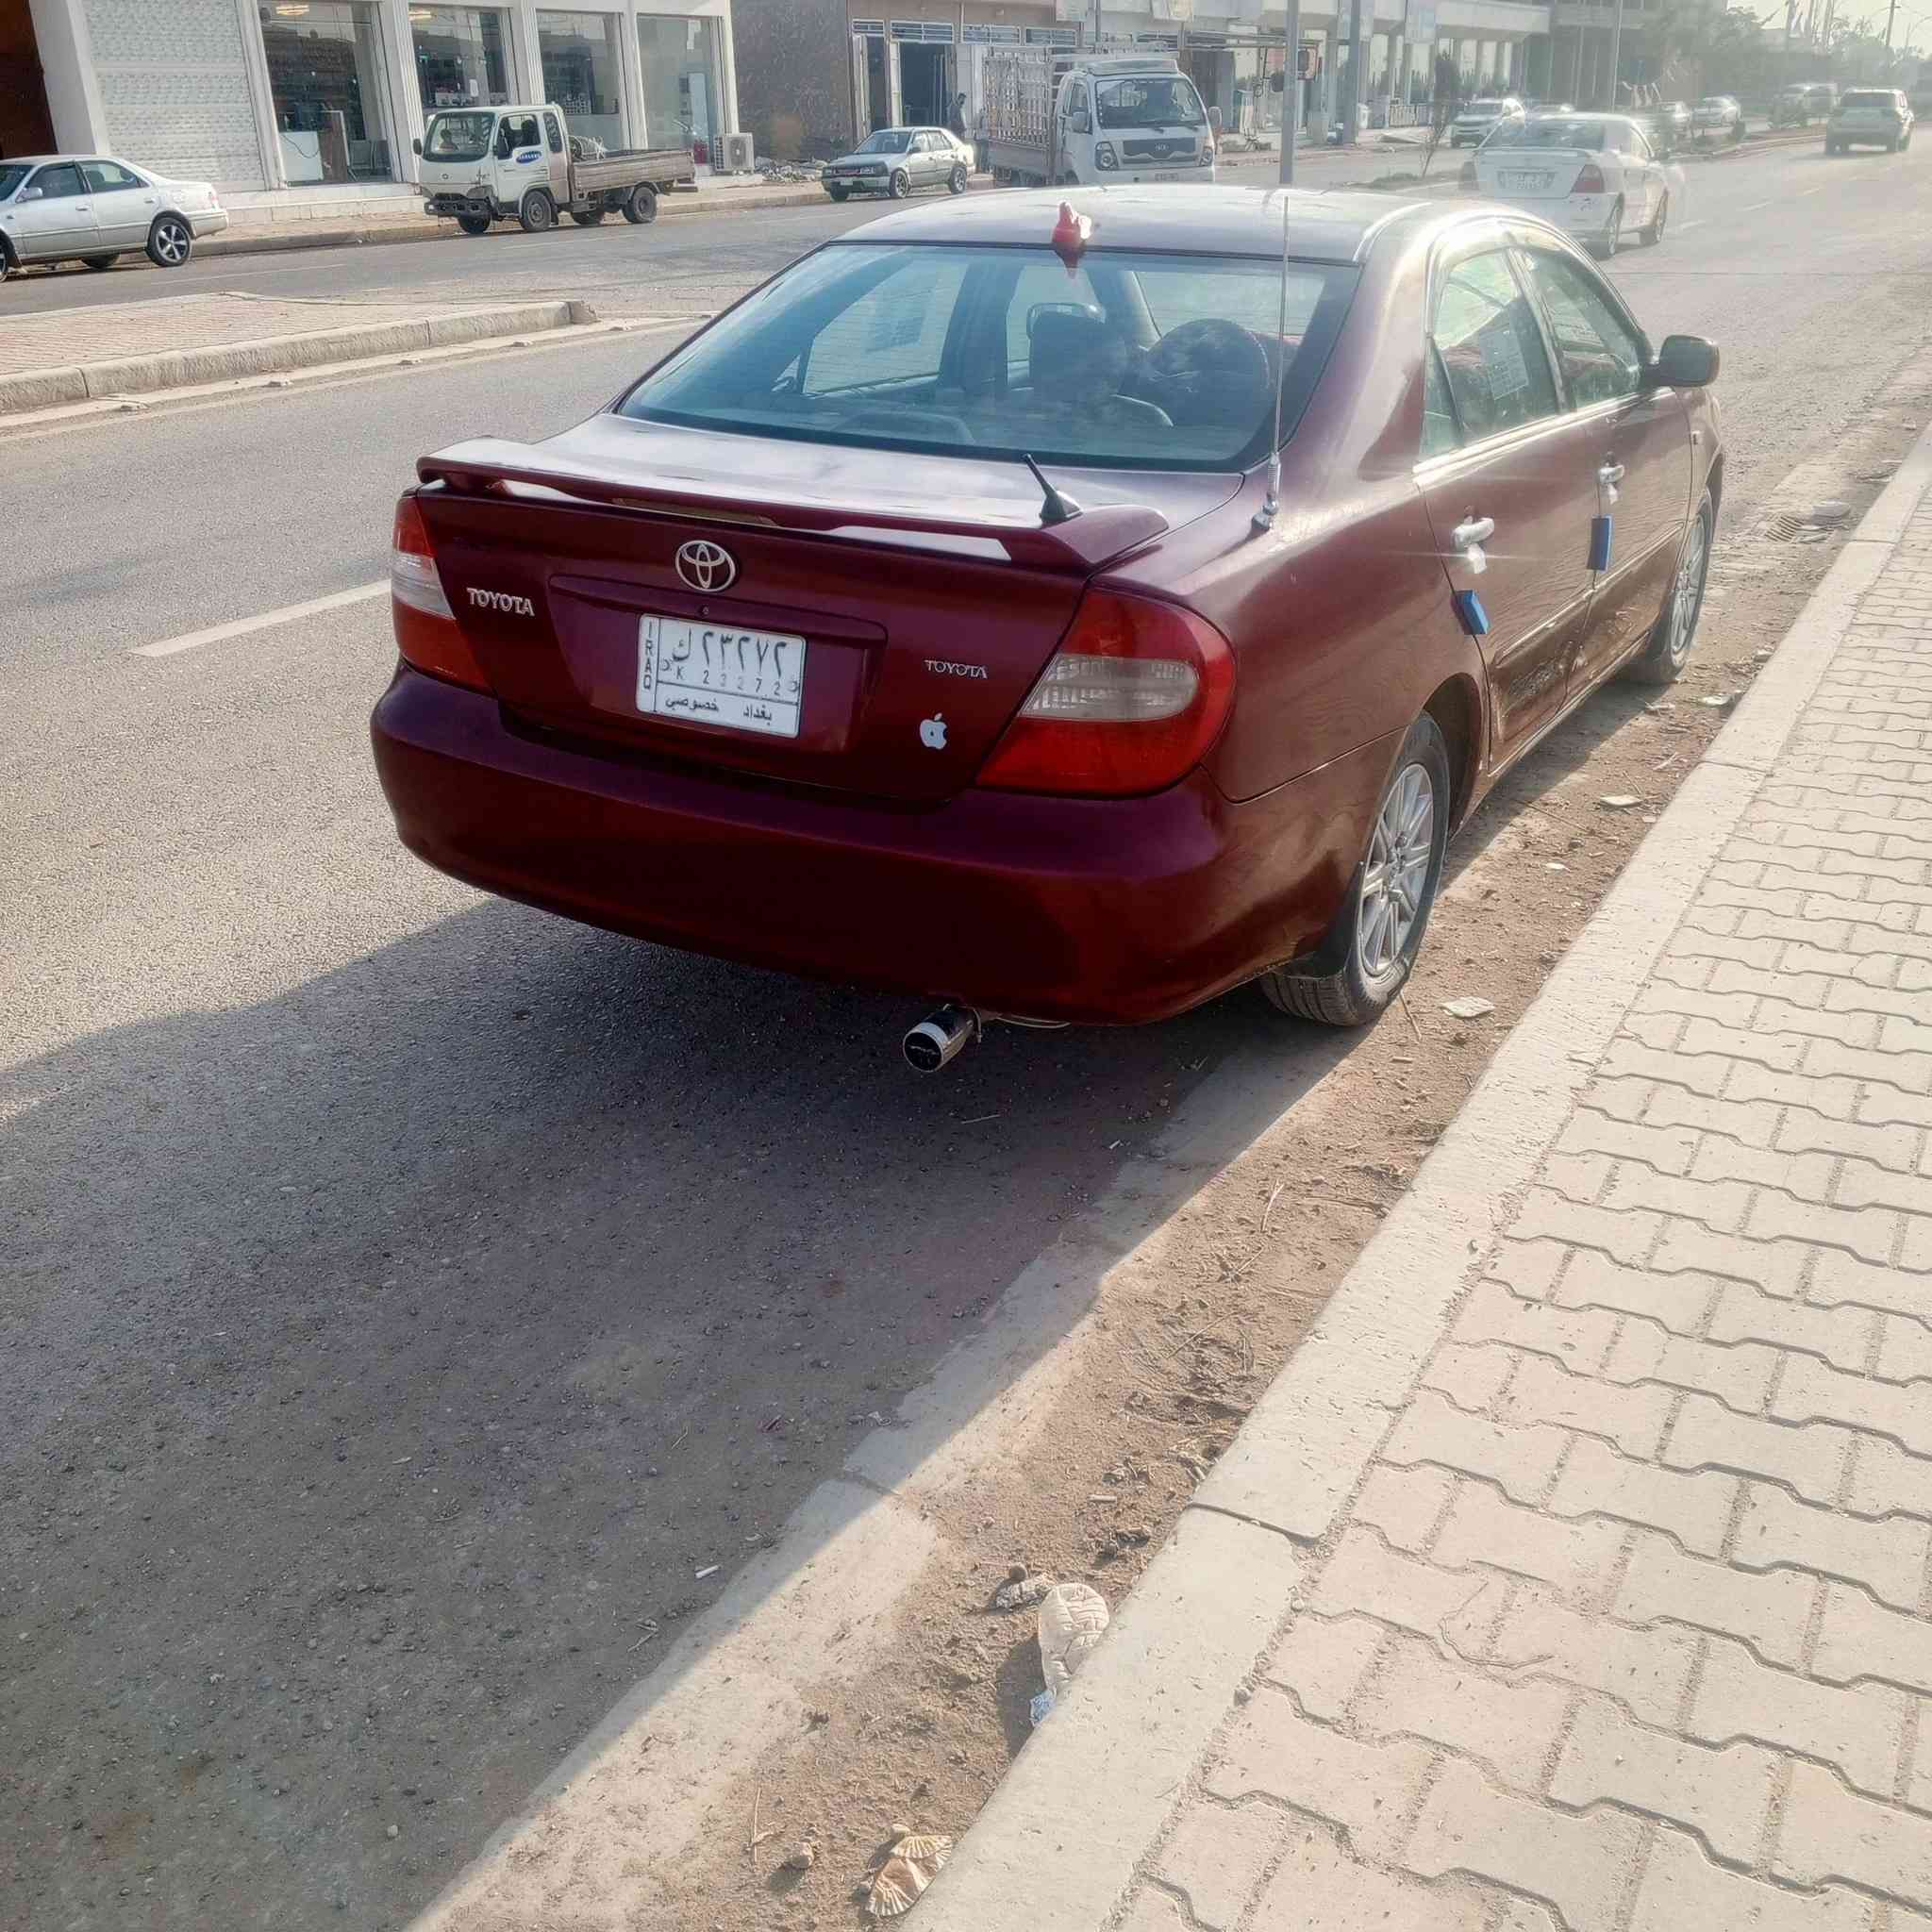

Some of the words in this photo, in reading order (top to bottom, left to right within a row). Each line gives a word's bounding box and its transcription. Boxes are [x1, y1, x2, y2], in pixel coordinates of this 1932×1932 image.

[466, 587, 535, 616] TOYOTA
[643, 621, 653, 690] IRAQ
[676, 666, 685, 679] K
[924, 659, 988, 679] TOYOTA
[665, 697, 719, 712] خصوصي
[742, 704, 773, 725] بغداد
